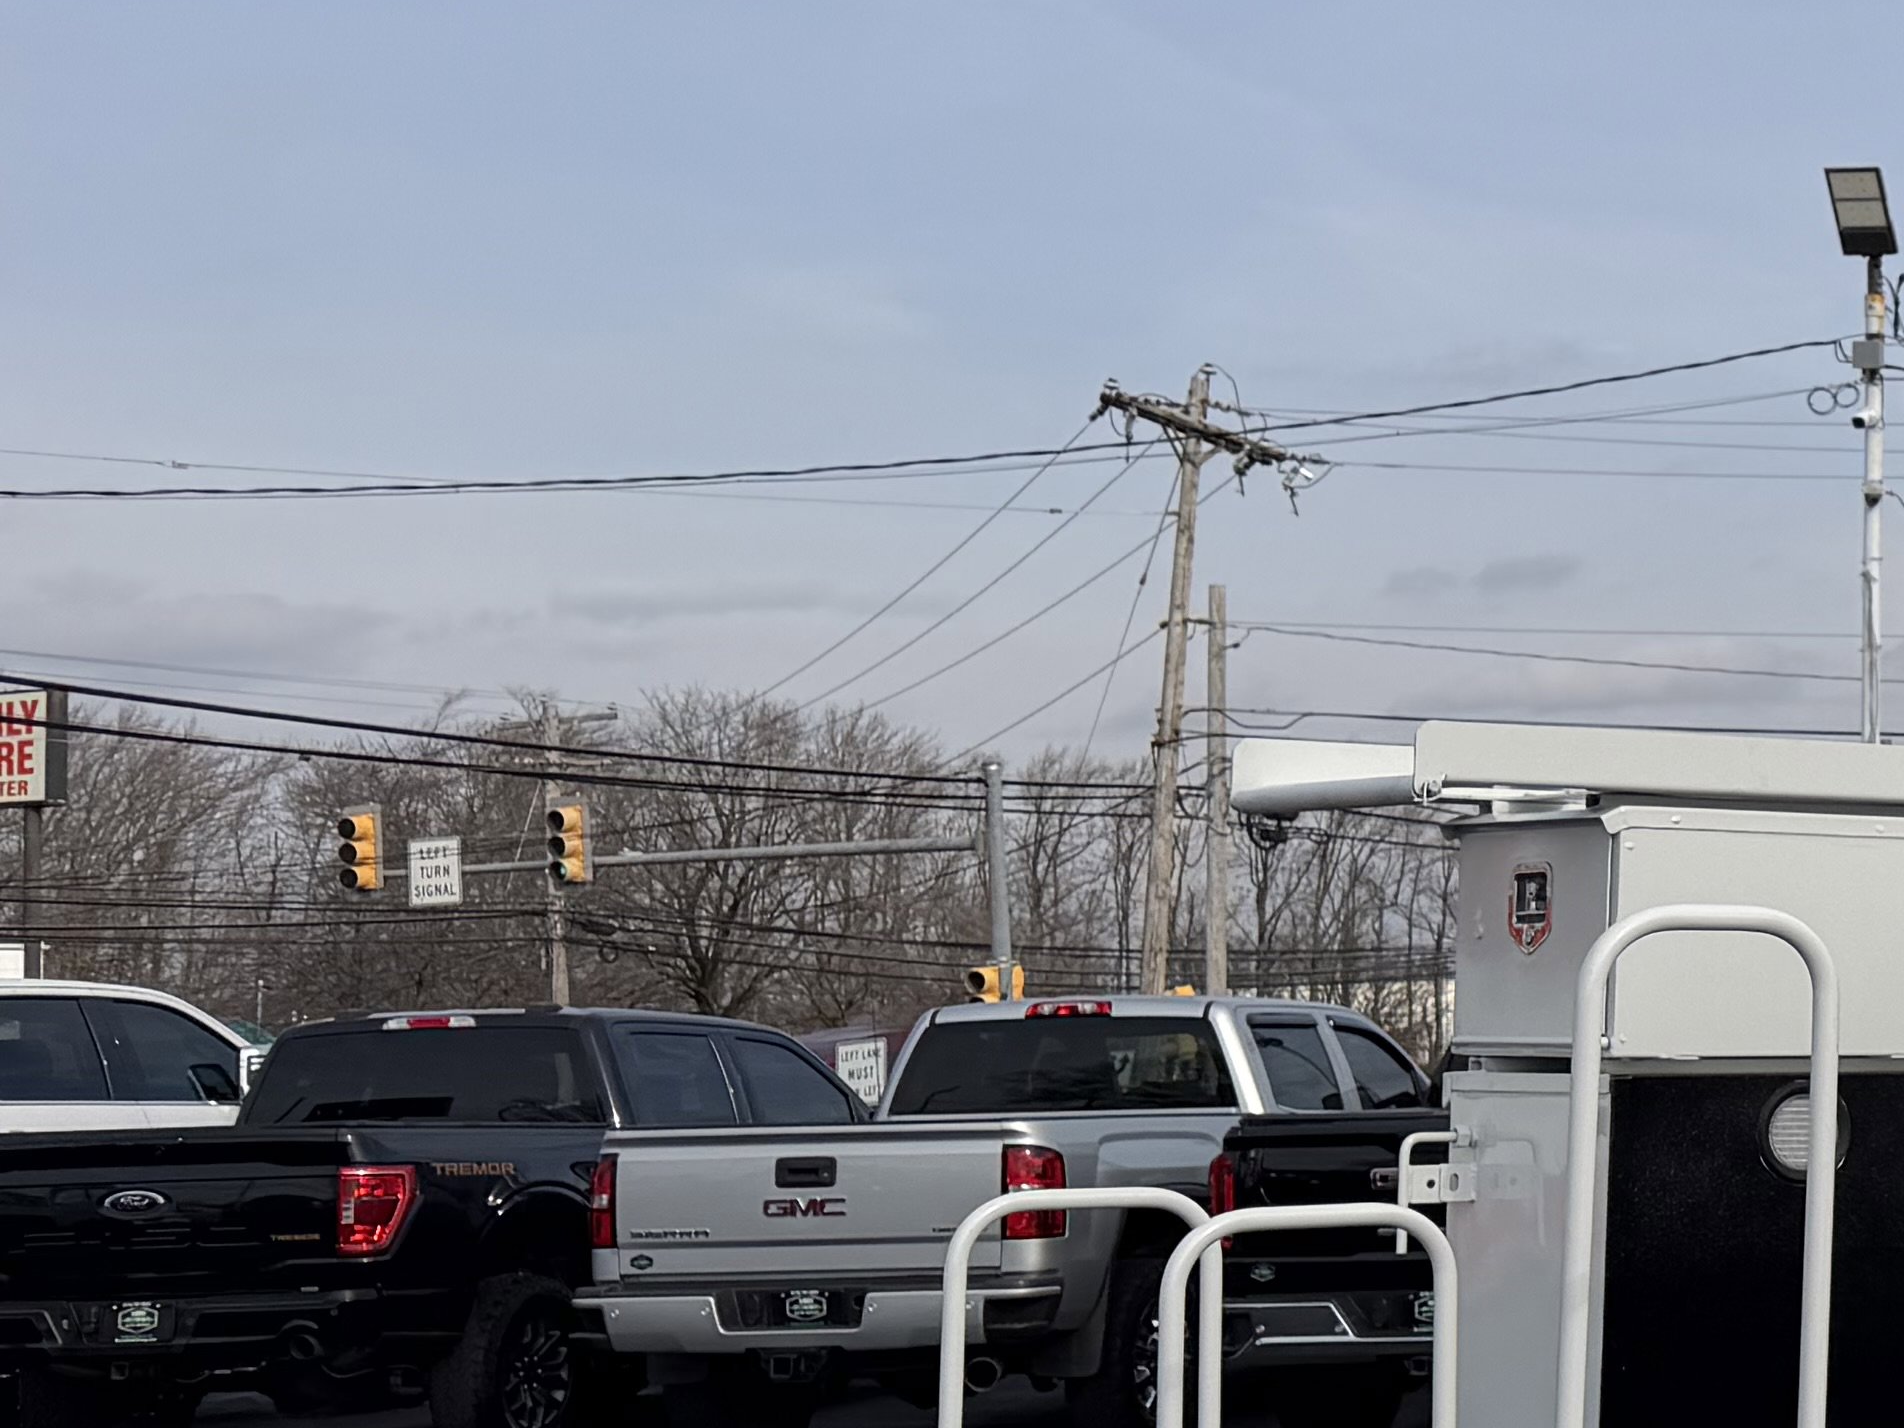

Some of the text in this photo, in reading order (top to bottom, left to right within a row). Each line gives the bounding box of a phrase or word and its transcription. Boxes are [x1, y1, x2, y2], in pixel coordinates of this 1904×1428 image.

[0, 740, 34, 776] RE
[420, 865, 450, 879] TURN
[414, 883, 457, 898] SIGNAL
[848, 1065, 874, 1080] MUST
[431, 1162, 516, 1176] TREMOR
[763, 1198, 847, 1217] GMC
